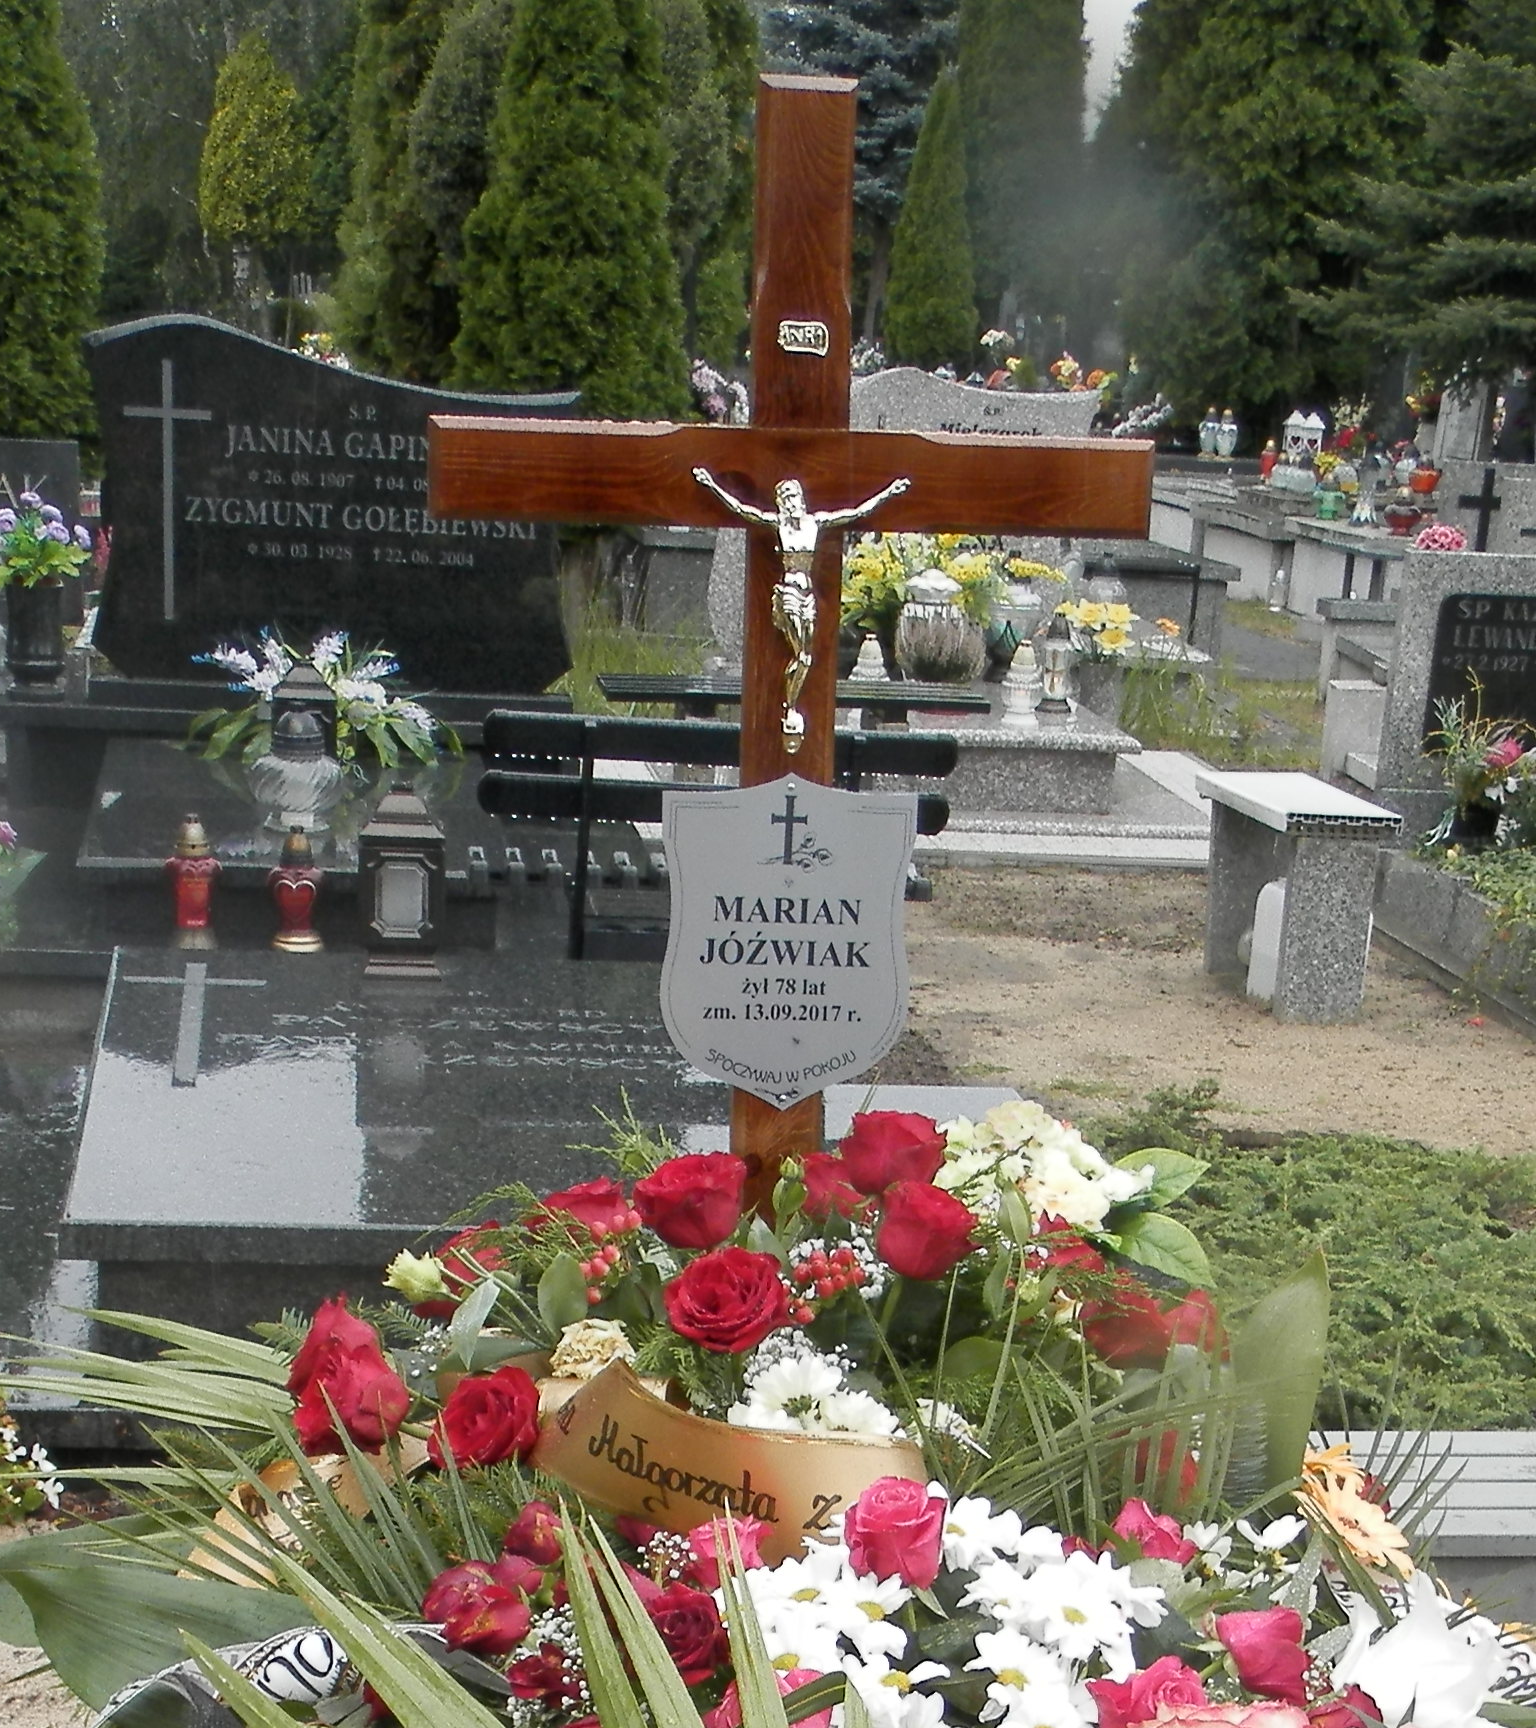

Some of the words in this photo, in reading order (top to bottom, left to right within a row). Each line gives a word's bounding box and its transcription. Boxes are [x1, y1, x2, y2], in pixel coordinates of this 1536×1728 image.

[225, 425, 335, 458] JANINA
[344, 433, 430, 461] GAPIN
[184, 497, 333, 529] ZYGMUNT
[713, 895, 863, 925] MARIAN
[699, 931, 871, 968] JÓŹWIAK
[741, 978, 769, 999] żył
[775, 978, 796, 995] 78
[802, 979, 826, 996] lat
[702, 1006, 736, 1021] zm.
[744, 1003, 842, 1022] 13.09.2017
[846, 1008, 862, 1022] r.
[705, 1048, 784, 1084] SPOCZYWAJ
[785, 1071, 800, 1084] W
[803, 1050, 857, 1080] POKOJU
